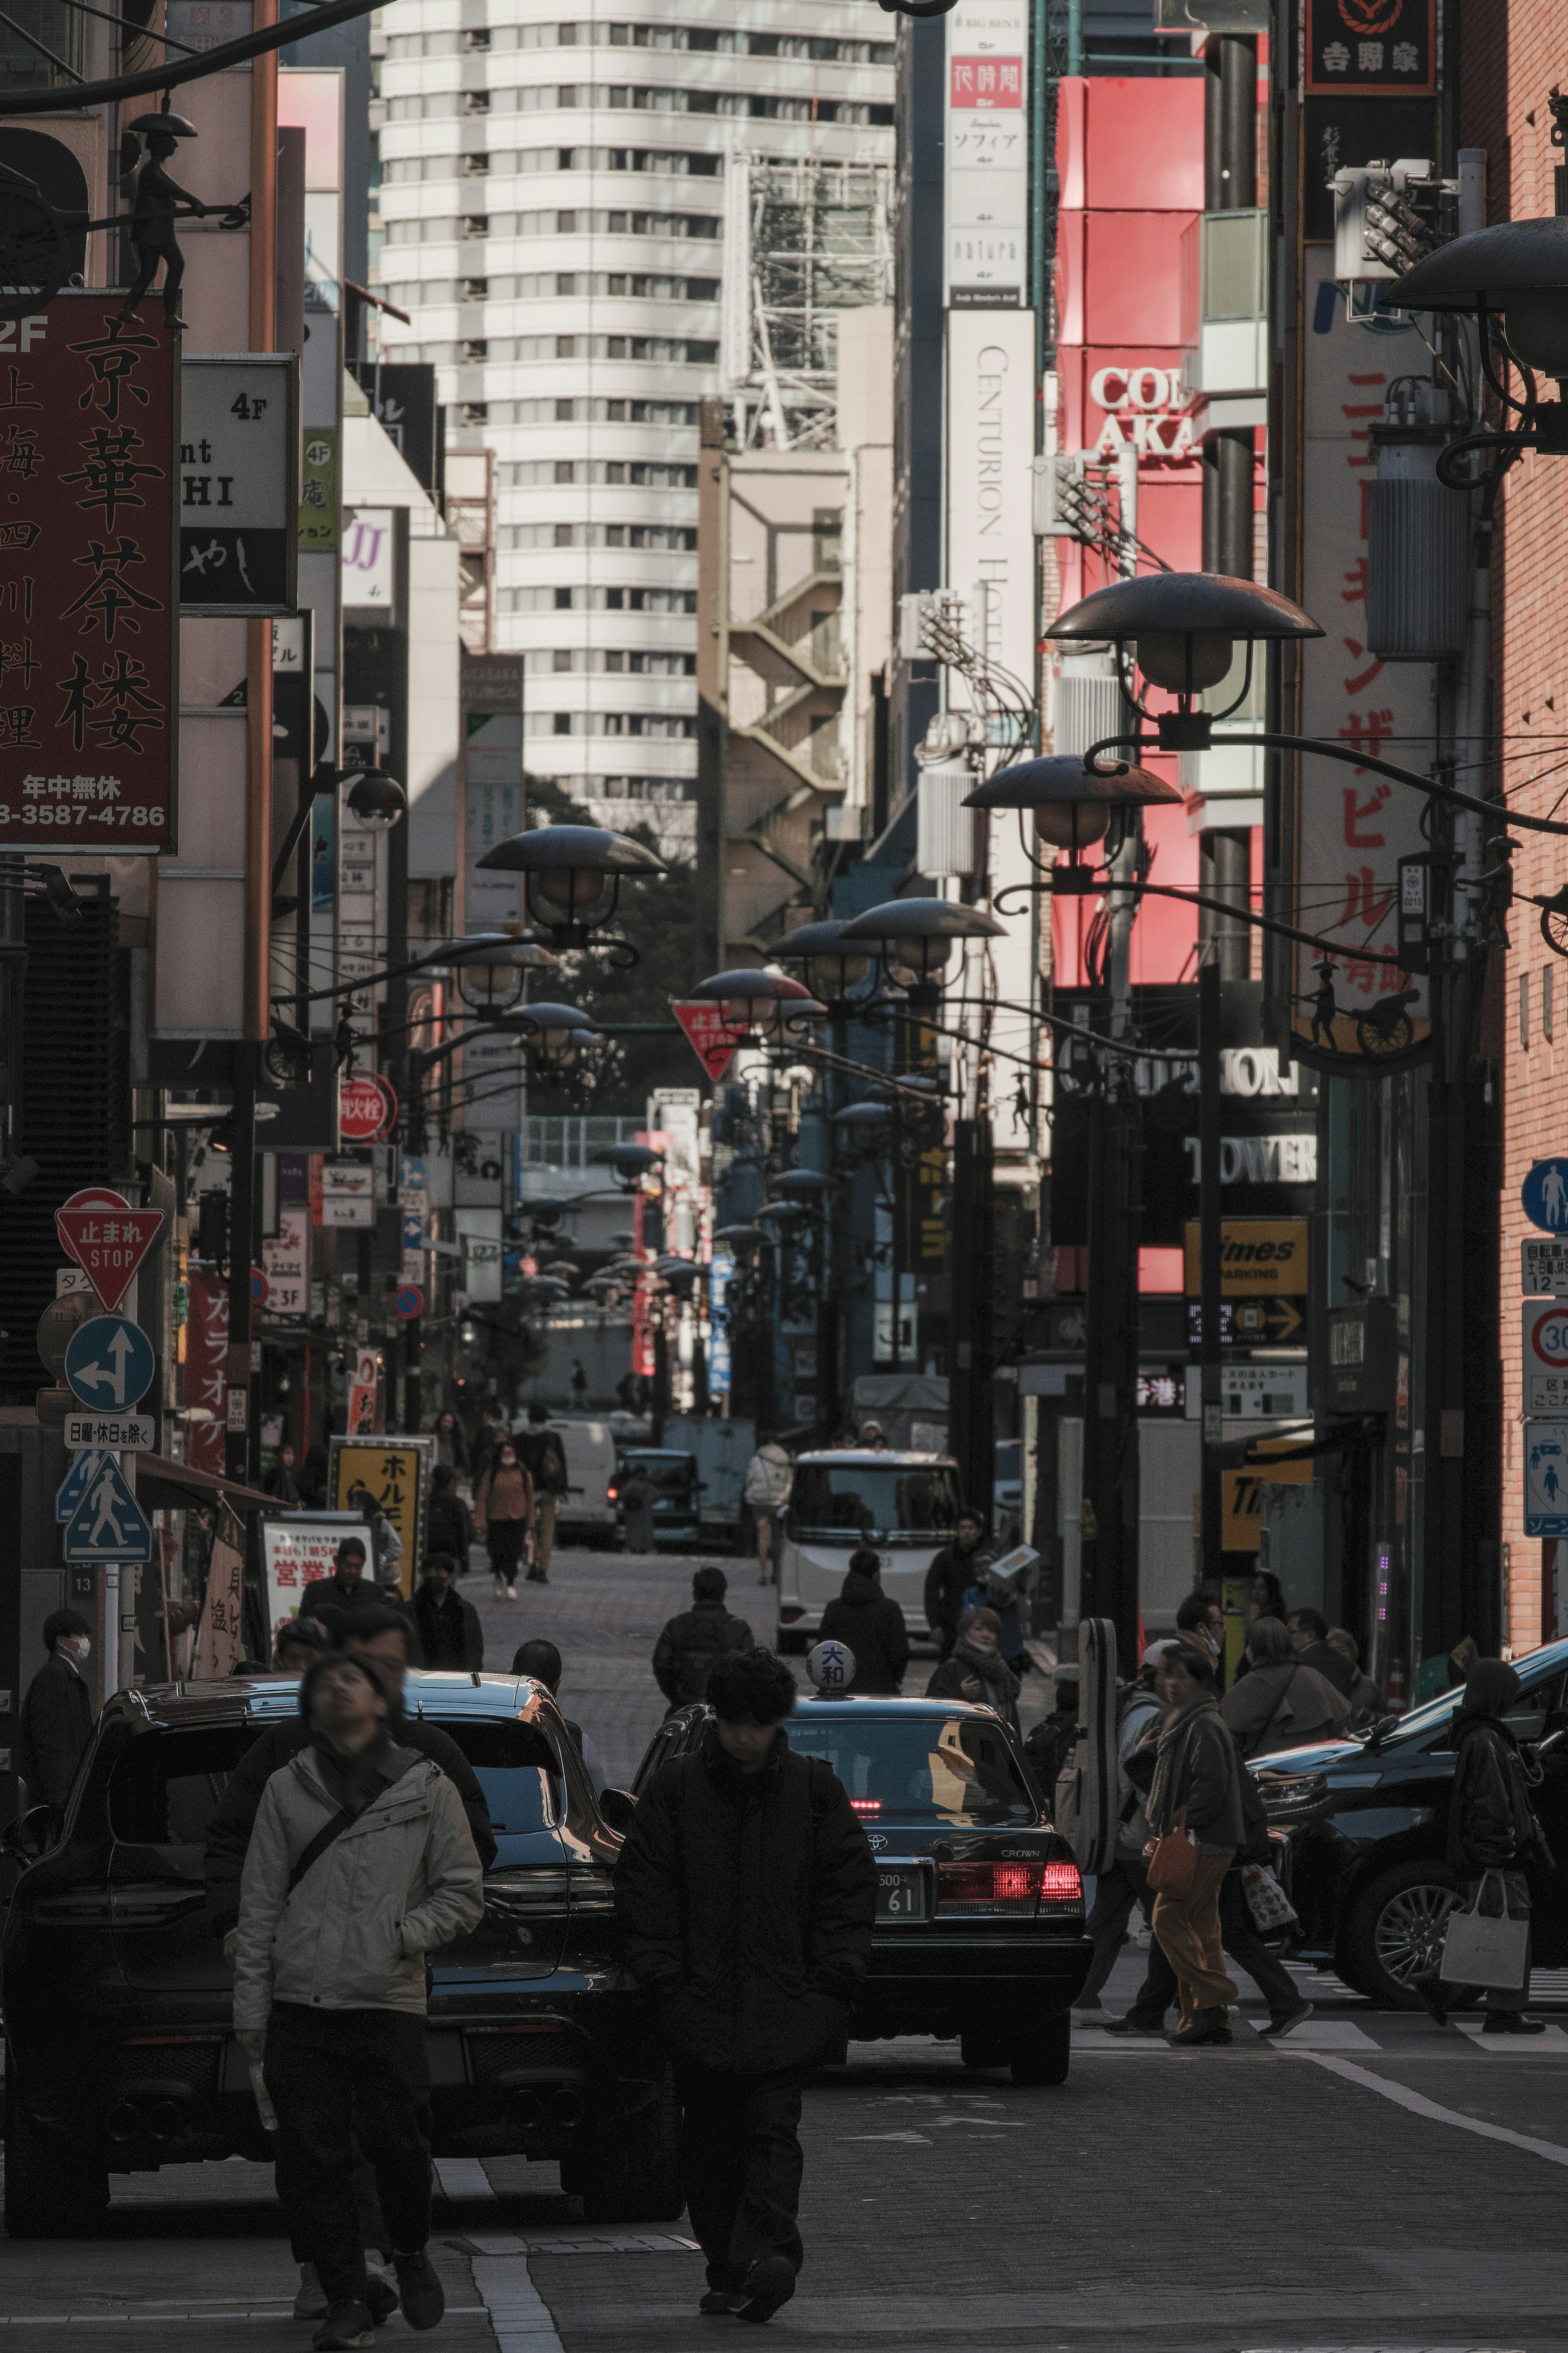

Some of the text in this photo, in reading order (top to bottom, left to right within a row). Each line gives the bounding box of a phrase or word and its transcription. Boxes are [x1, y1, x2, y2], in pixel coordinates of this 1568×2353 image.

[955, 134, 1018, 149] ソフィア
[231, 393, 267, 419] 4F
[976, 346, 1009, 535] CENTURION
[303, 479, 326, 508] 庵
[55, 314, 165, 754] 京華茶楼
[22, 775, 121, 799] 年中無休
[79, 1221, 143, 1244] 止まれ
[91, 1250, 134, 1267] STOP
[200, 1289, 228, 1446] カラオケ
[70, 1422, 148, 1445] 日曜・休日を除く
[76, 1578, 91, 1592] 13
[822, 1646, 844, 1685] 大和
[1001, 1849, 1040, 1858] CROWN
[879, 1874, 900, 1887] 500
[889, 1889, 912, 1911] 61
